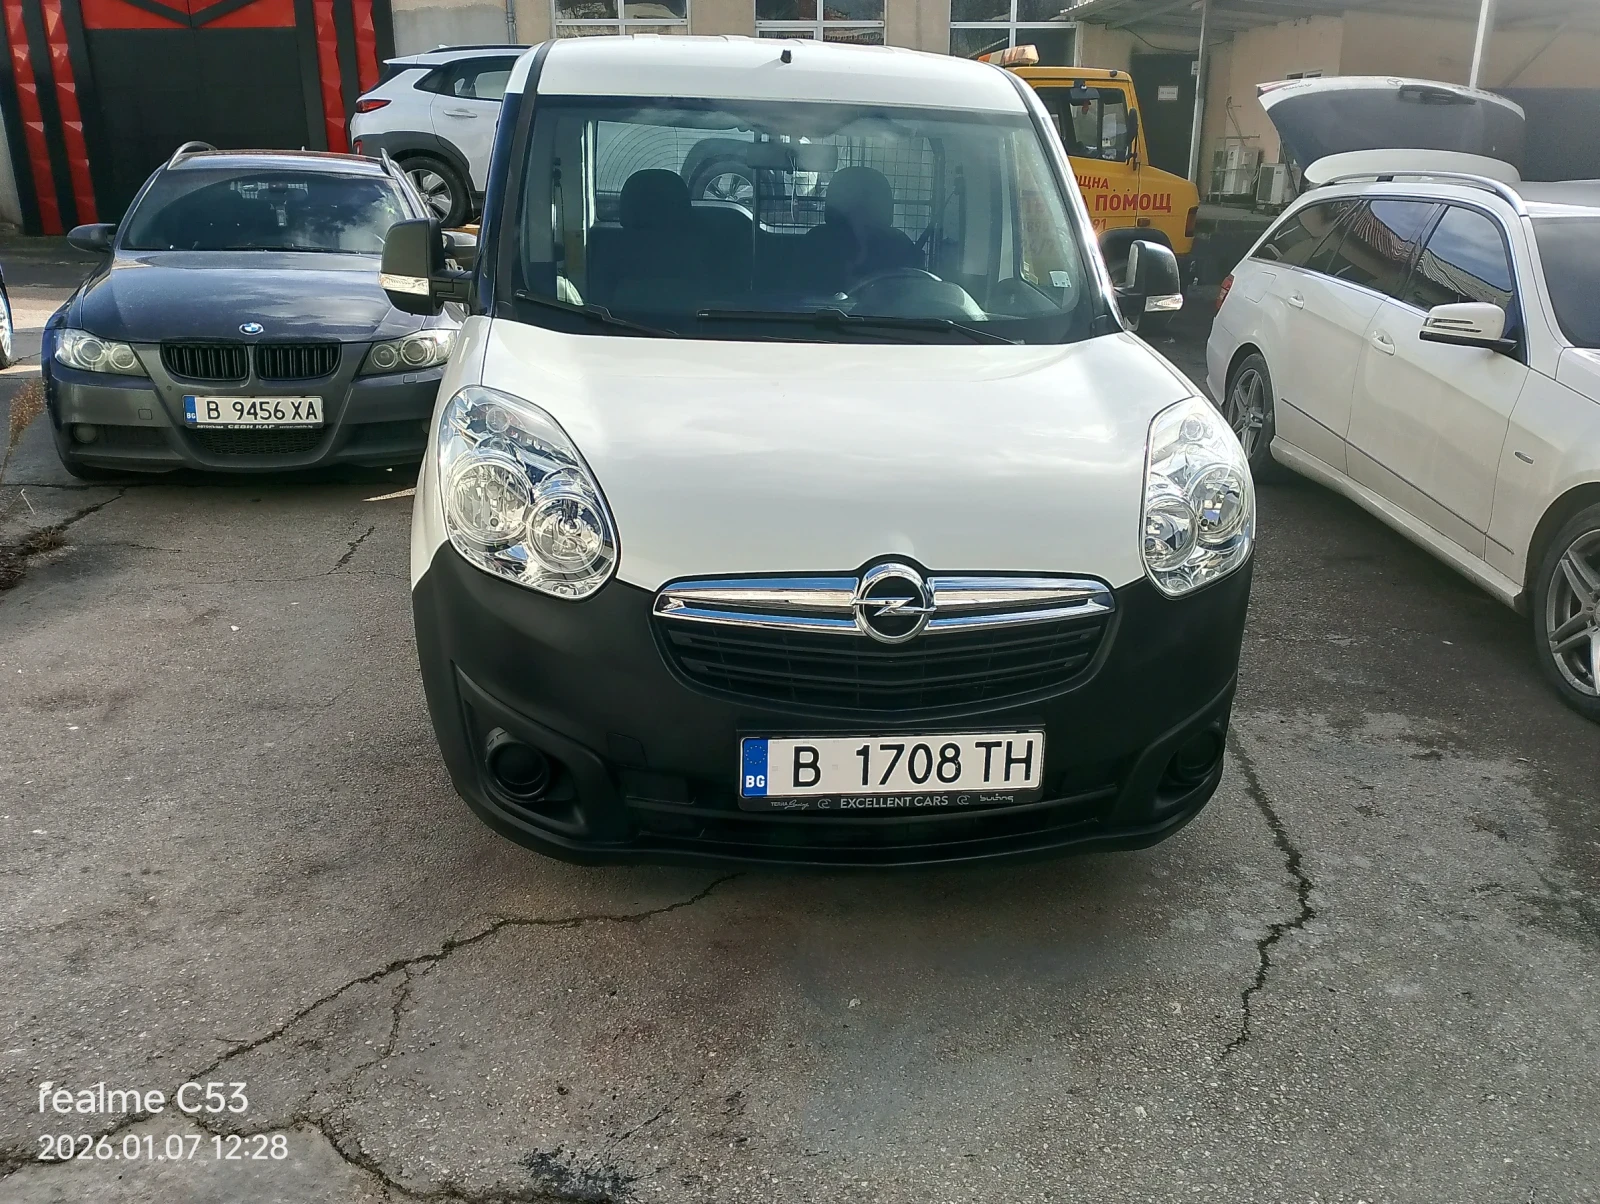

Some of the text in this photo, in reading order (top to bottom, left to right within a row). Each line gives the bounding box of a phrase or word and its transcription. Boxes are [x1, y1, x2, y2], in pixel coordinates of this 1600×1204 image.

[1095, 193, 1172, 213] ПОМОЩ
[206, 400, 221, 420] B
[232, 401, 286, 421] 9456
[291, 400, 318, 420] XA
[745, 740, 1034, 788] BG B 1708 TH
[840, 796, 912, 809] EXCELLENT
[914, 795, 949, 808] CARS
